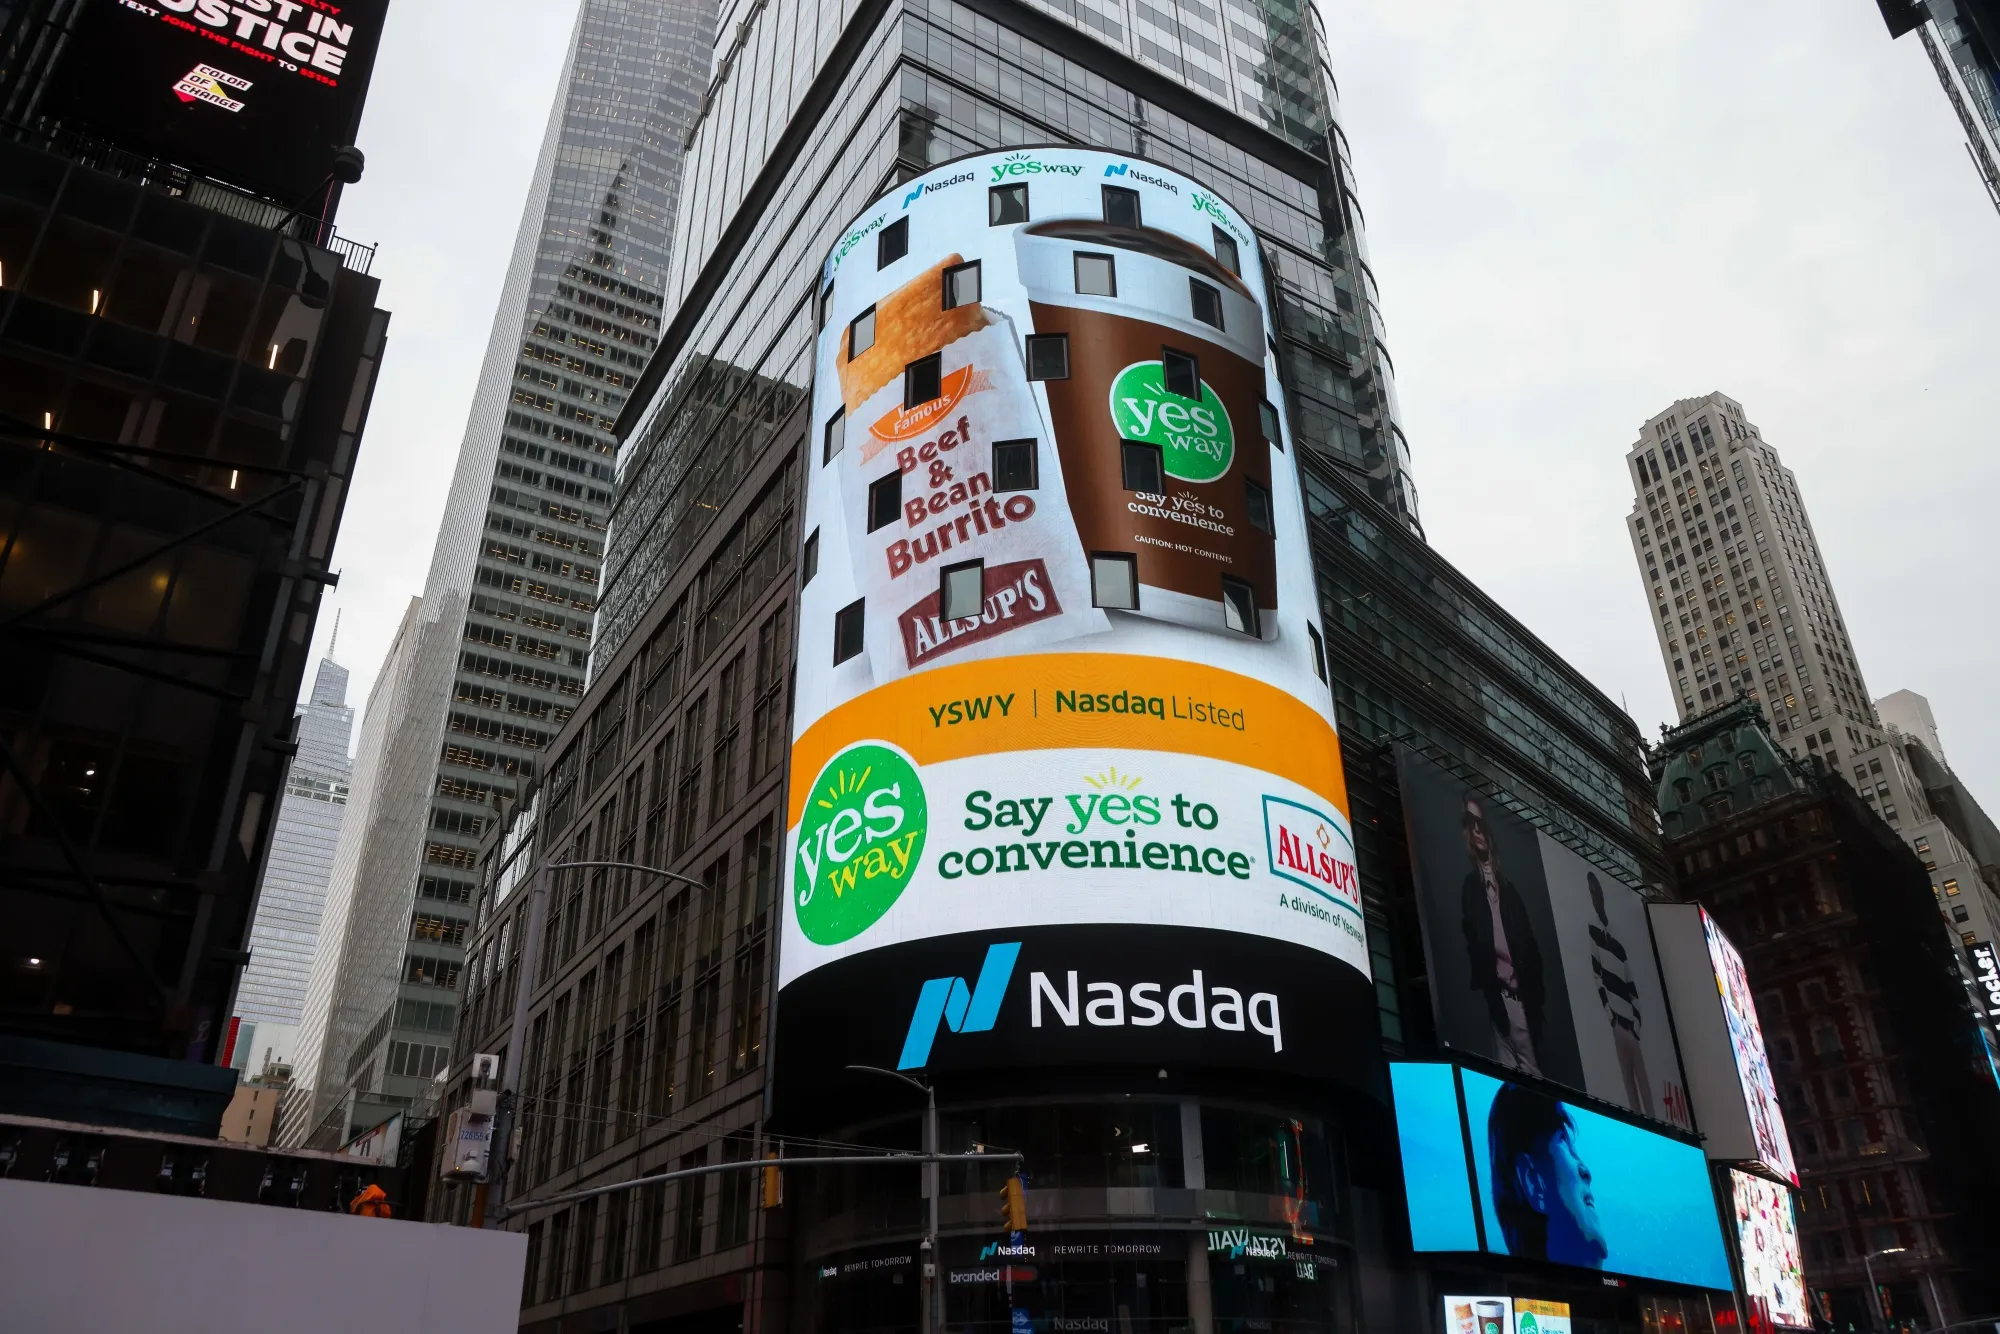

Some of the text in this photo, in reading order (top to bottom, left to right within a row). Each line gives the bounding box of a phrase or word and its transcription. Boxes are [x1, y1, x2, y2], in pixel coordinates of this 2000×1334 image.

[307, 11, 354, 46] IN
[160, 14, 197, 33] JOIN
[199, 28, 230, 45] THE
[231, 41, 276, 62] FIGHT
[277, 59, 298, 72] TO
[300, 67, 338, 87] 55156
[189, 75, 211, 85] OF
[199, 66, 248, 88] COLOR
[179, 83, 240, 110] CHANGE
[924, 171, 975, 195] Nasdaq
[991, 160, 1084, 183] yesway
[1129, 169, 1178, 196] Nasdaq
[1191, 192, 1250, 247] yesway
[833, 211, 889, 272] yesway
[893, 393, 952, 435] Famous
[1121, 397, 1218, 437] yes
[896, 414, 971, 476] Beef
[1163, 431, 1226, 462] way
[928, 459, 954, 489] &
[904, 471, 993, 529] Bean
[1135, 491, 1225, 520] Say yes to
[1127, 501, 1235, 537] convenience
[885, 494, 1037, 581] Burrito
[1134, 534, 1233, 564] CAUTION: HOT CONTENTS
[928, 690, 1246, 732] YSWY Nasdaq Listed
[964, 790, 1219, 837] Say yes to
[798, 782, 905, 908] yes
[938, 829, 1250, 880] convenience
[828, 831, 919, 899] way
[1278, 824, 1358, 905] ALLSUP'S
[1280, 894, 1289, 909] A
[1291, 897, 1331, 924] division
[1332, 914, 1342, 929] of
[1030, 970, 1282, 1053] Nasdaq
[844, 1261, 869, 1273] REWRITE
[871, 1255, 912, 1269] TOMORROW
[998, 1244, 1161, 1257] Nasdaq REWRITE TOMORROW
[1246, 1246, 1275, 1260] Nasdaq
[1287, 1251, 1313, 1261] REWRITE
[950, 1269, 1000, 1284] branded
[1053, 1316, 1109, 1332] Nasdaq
